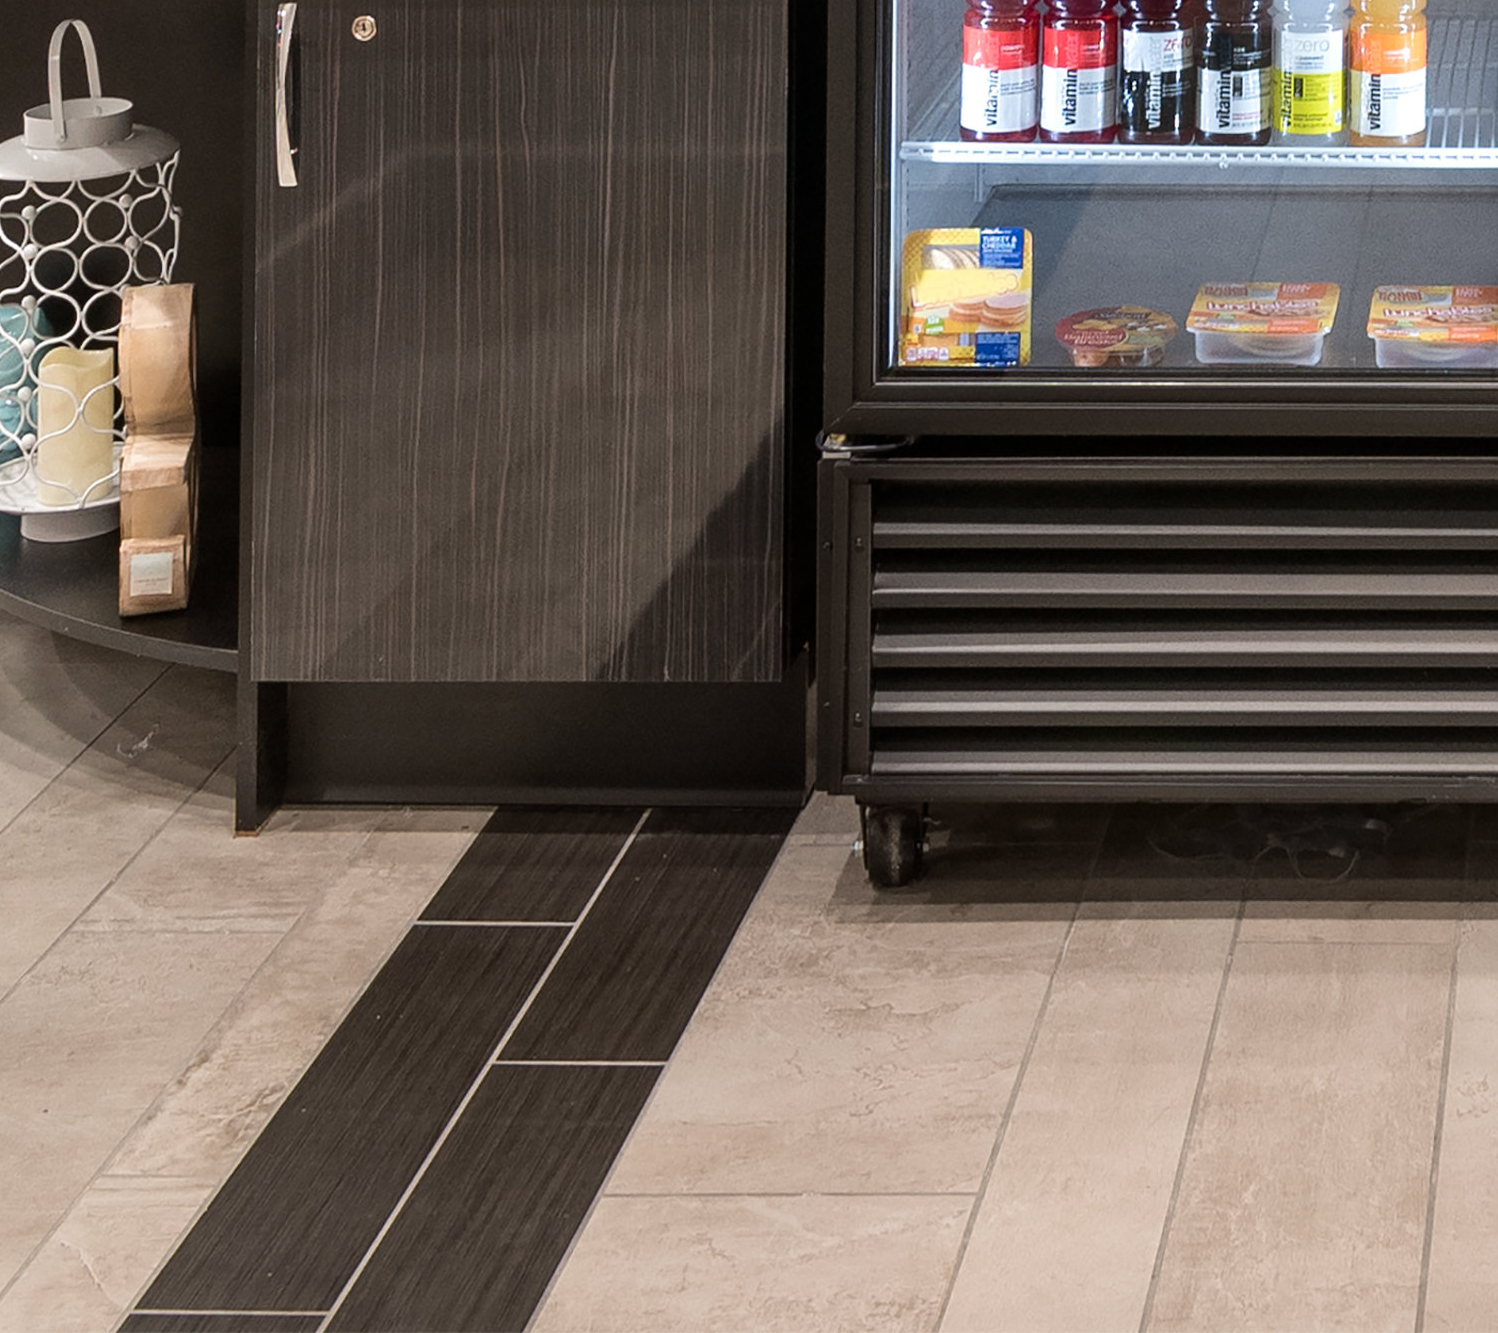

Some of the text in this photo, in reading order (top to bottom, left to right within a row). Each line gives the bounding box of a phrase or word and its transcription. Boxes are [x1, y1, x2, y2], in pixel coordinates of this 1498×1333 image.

[1295, 39, 1330, 52] zero
[1218, 70, 1231, 129] vitamin
[1369, 74, 1381, 131] vitamin
[982, 235, 1009, 243] TURKEY
[982, 242, 1016, 250] CHEDDAR
